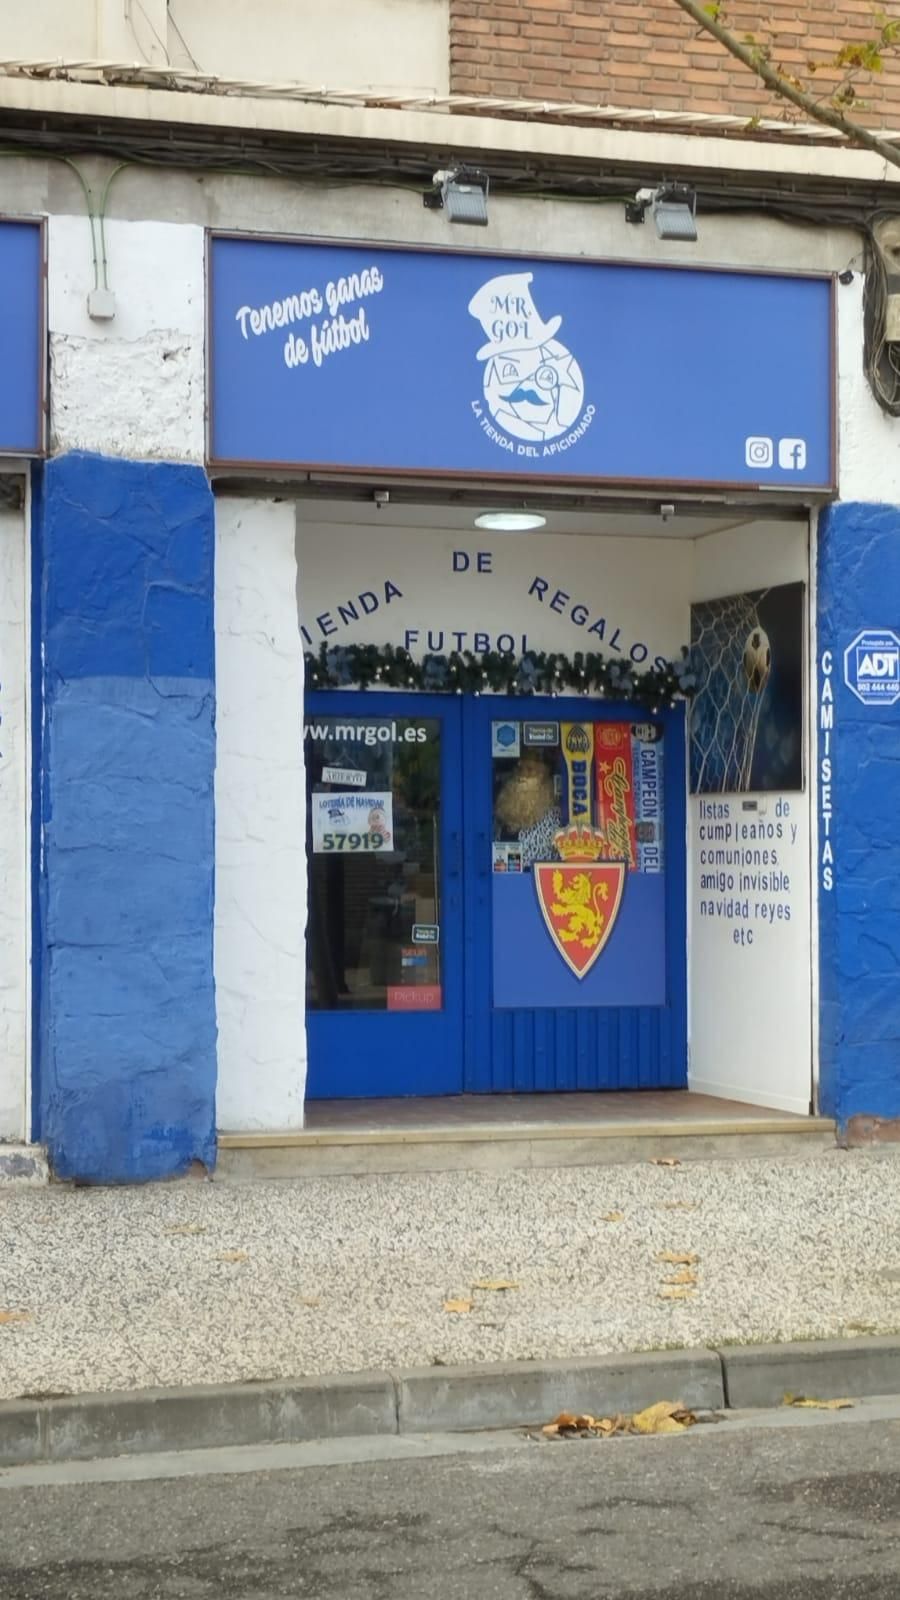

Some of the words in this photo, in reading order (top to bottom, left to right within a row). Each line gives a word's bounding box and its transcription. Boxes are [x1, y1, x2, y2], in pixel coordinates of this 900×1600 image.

[235, 288, 323, 340] Tenemos
[325, 266, 384, 316] ganas
[489, 294, 532, 320] MR.
[284, 332, 309, 369] de
[311, 307, 370, 367] fútbol
[491, 319, 534, 343] GOL
[471, 400, 483, 419] LA
[480, 416, 514, 453] TIENDA
[517, 446, 540, 457] DEL
[542, 404, 596, 457] AFICIONADO
[300, 580, 403, 645] IENDA
[452, 551, 493, 573] DE
[858, 653, 897, 677] ADT
[304, 721, 427, 746] w.mrgol.es
[641, 749, 657, 818] CAMPEON
[820, 650, 834, 891] CAMISETAS
[700, 800, 730, 820] listas
[775, 797, 790, 818] de
[323, 833, 384, 850] 57919
[700, 819, 783, 842] cumpleaños
[791, 823, 797, 845] y
[643, 846, 660, 873] DEL
[700, 869, 734, 893] amigo
[700, 898, 749, 919] navidad
[754, 903, 791, 924] reyes
[733, 927, 753, 946] etc
